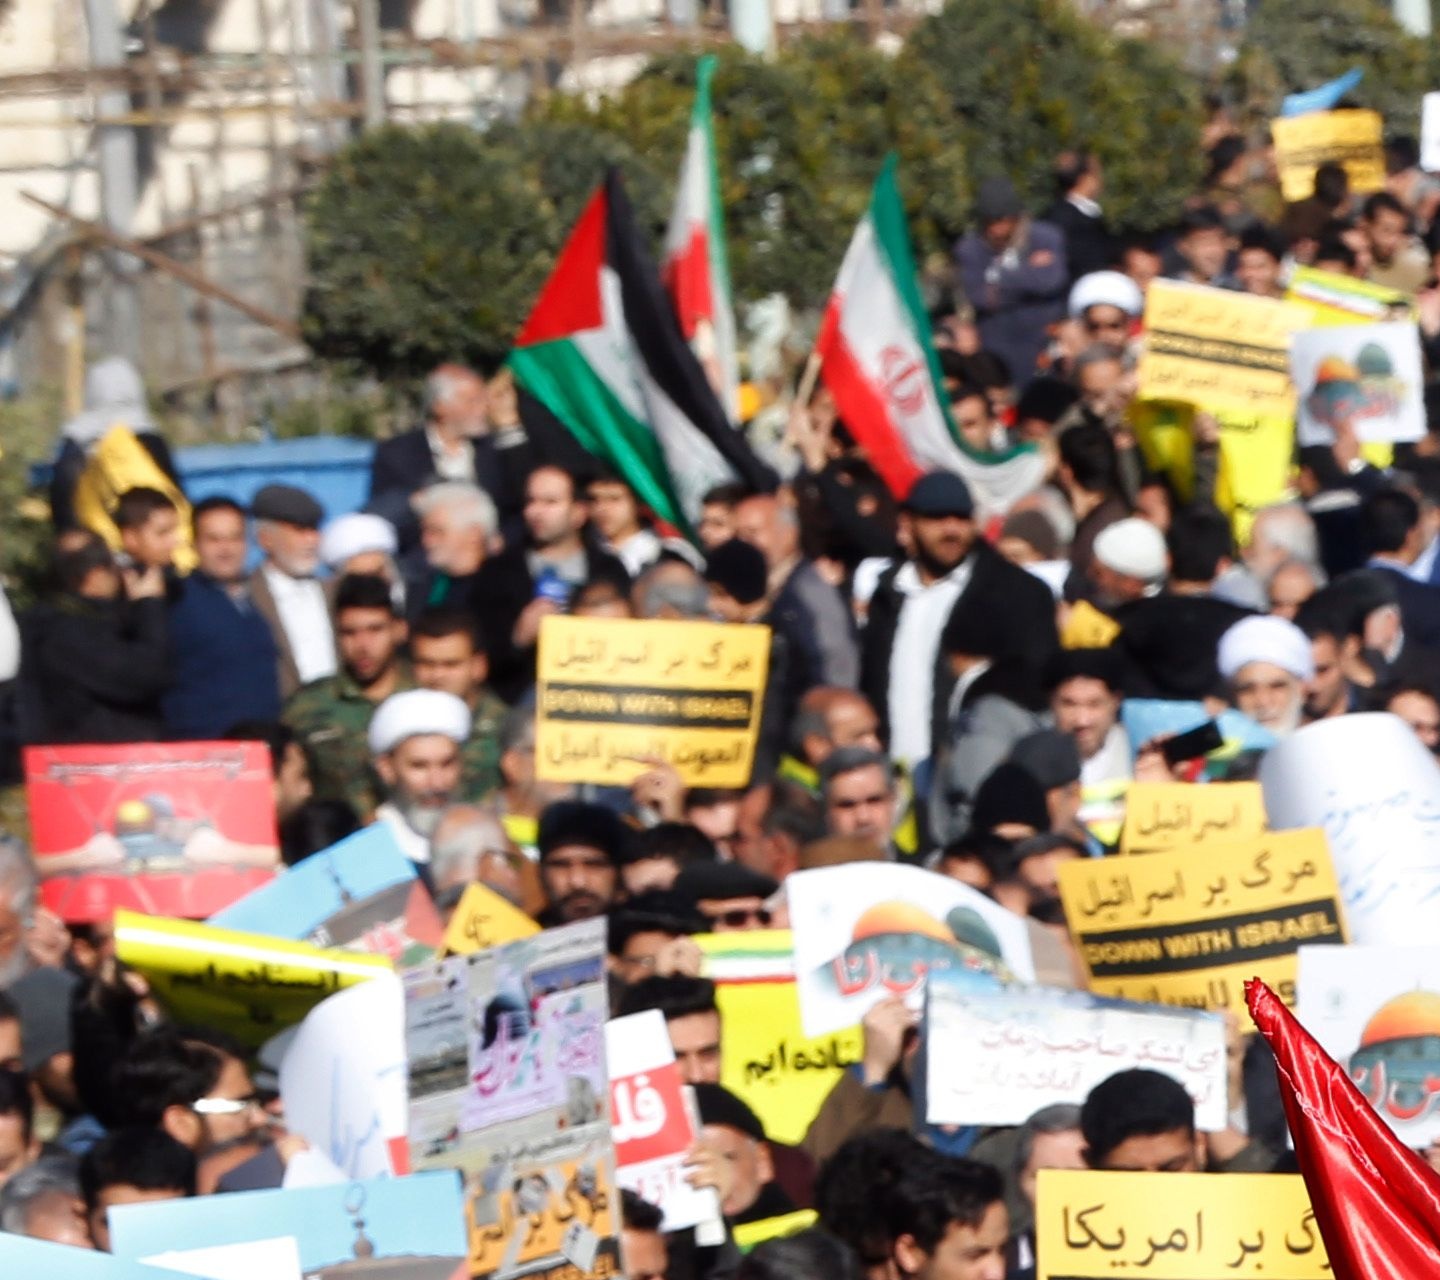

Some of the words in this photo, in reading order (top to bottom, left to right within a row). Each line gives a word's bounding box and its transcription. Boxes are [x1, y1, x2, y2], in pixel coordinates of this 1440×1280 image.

[1088, 937, 1163, 965] DOWN
[1169, 928, 1230, 954] WITH
[1236, 916, 1337, 948] ISRAEL
